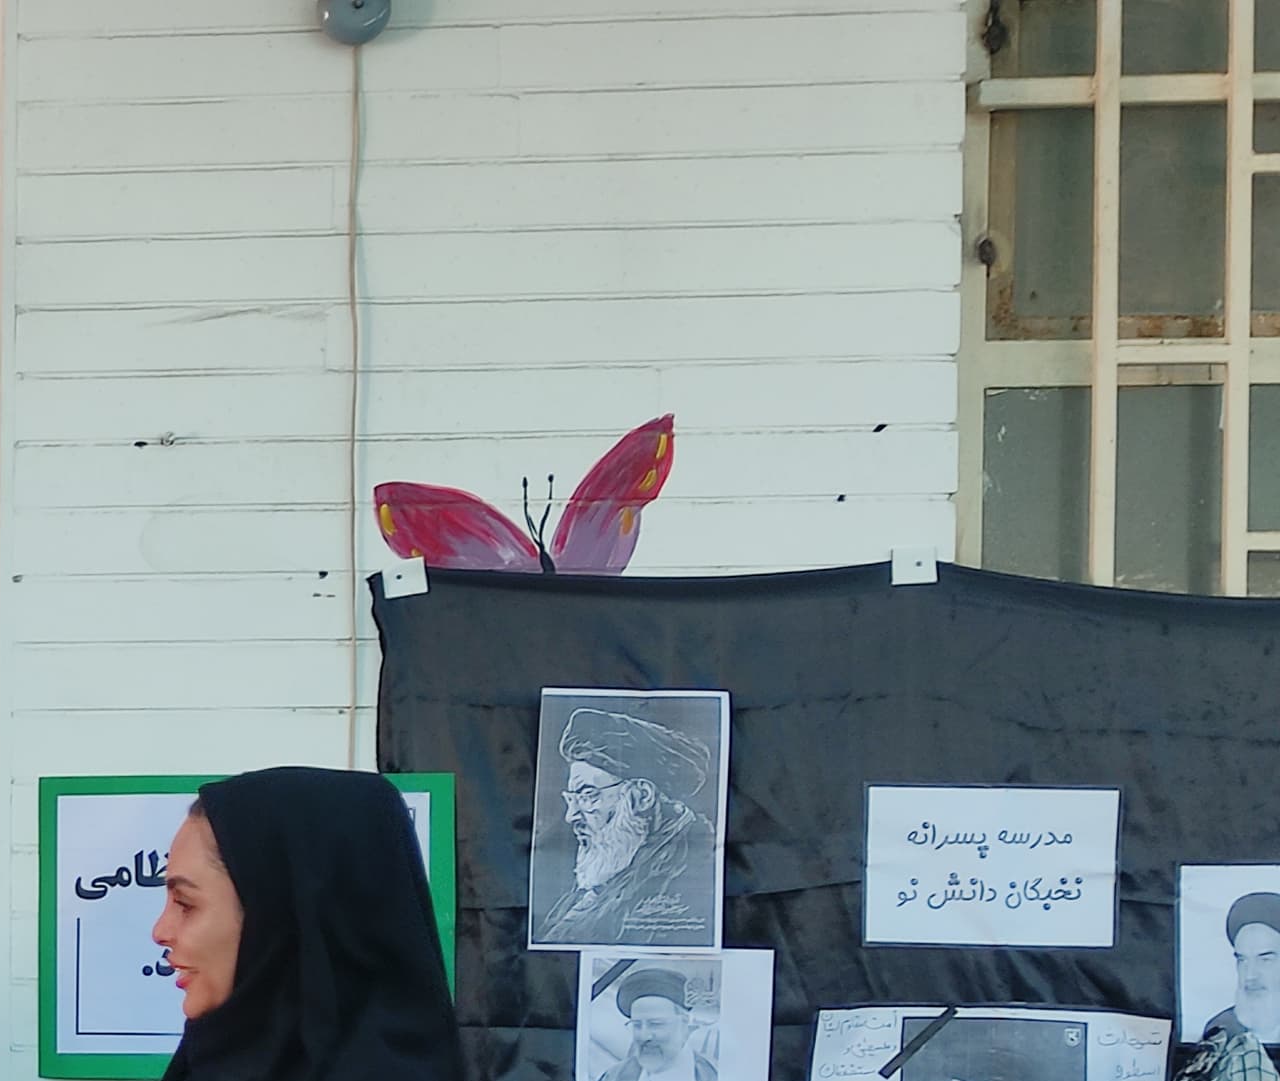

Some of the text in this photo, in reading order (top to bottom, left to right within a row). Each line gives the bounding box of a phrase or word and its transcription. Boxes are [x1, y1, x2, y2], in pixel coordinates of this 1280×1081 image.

[906, 821, 1073, 859] مدرسه پسرانه
[896, 871, 1083, 911] نخبگان دانش نو
